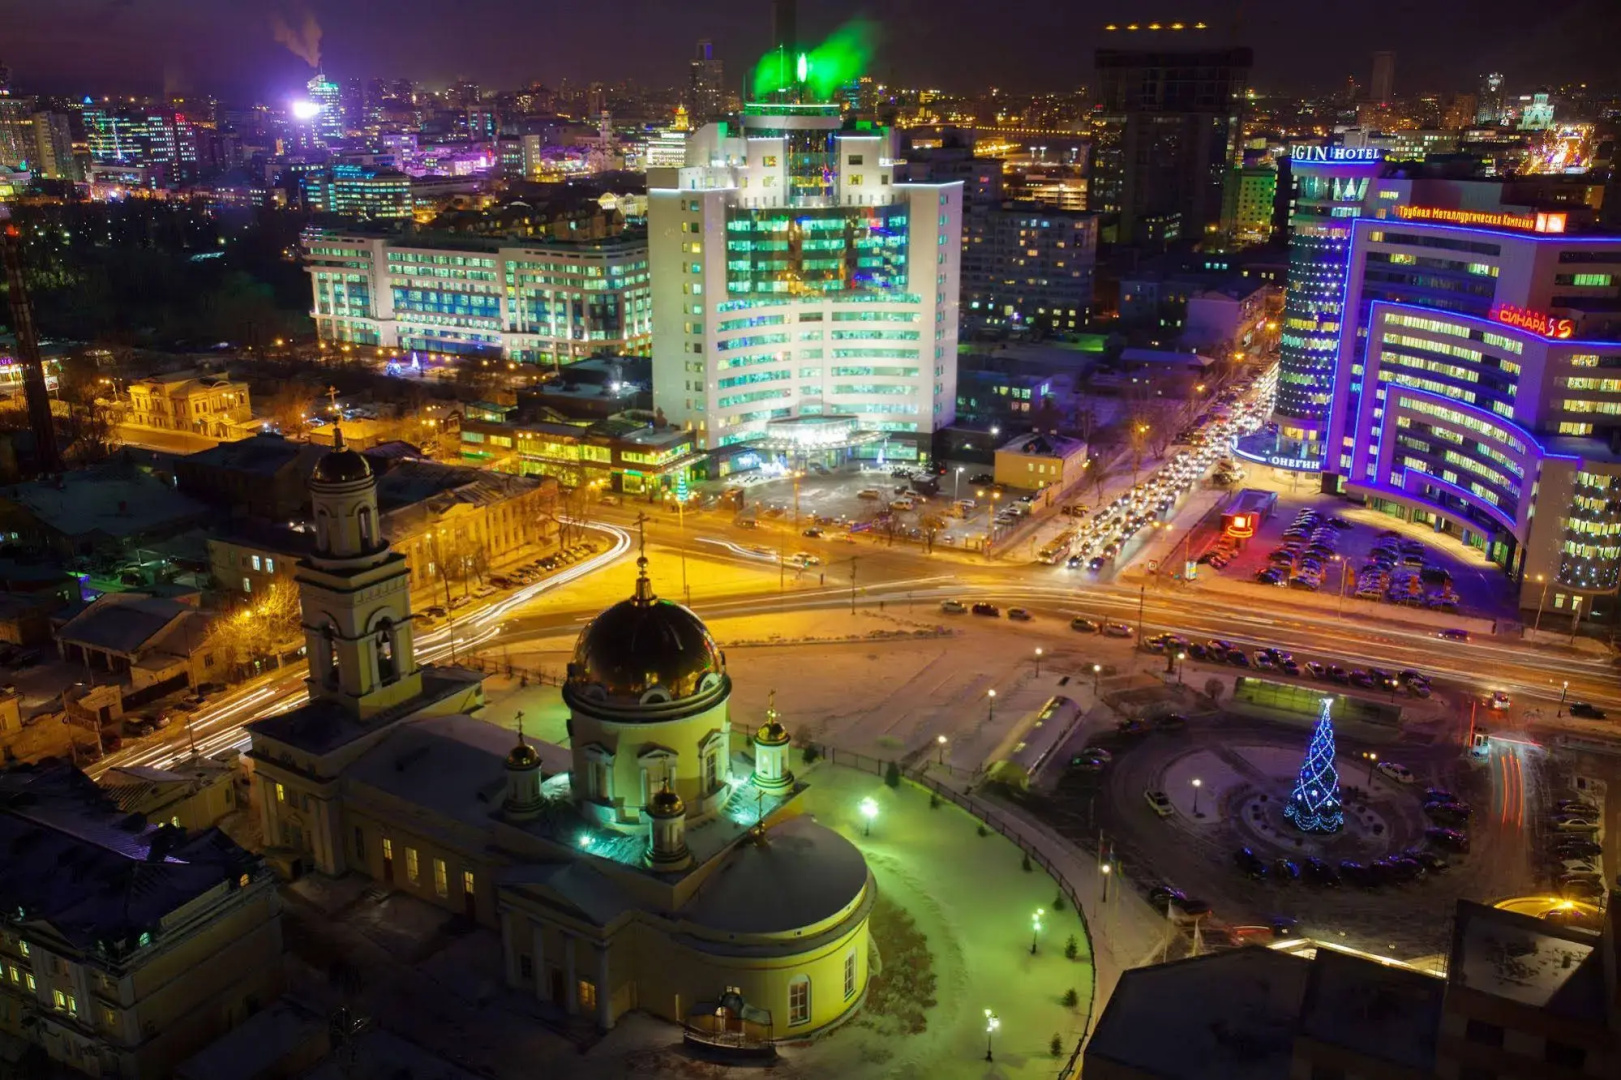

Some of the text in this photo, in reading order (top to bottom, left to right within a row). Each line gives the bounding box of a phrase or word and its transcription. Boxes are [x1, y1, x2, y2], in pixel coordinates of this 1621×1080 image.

[1334, 148, 1379, 159] HOTEL
[1399, 205, 1431, 218] Трубная
[1432, 207, 1501, 225] Металлургическая
[1502, 214, 1534, 229] Компания
[1500, 310, 1546, 334] СИНАРА
[1271, 456, 1321, 470] ОНЕГИН
